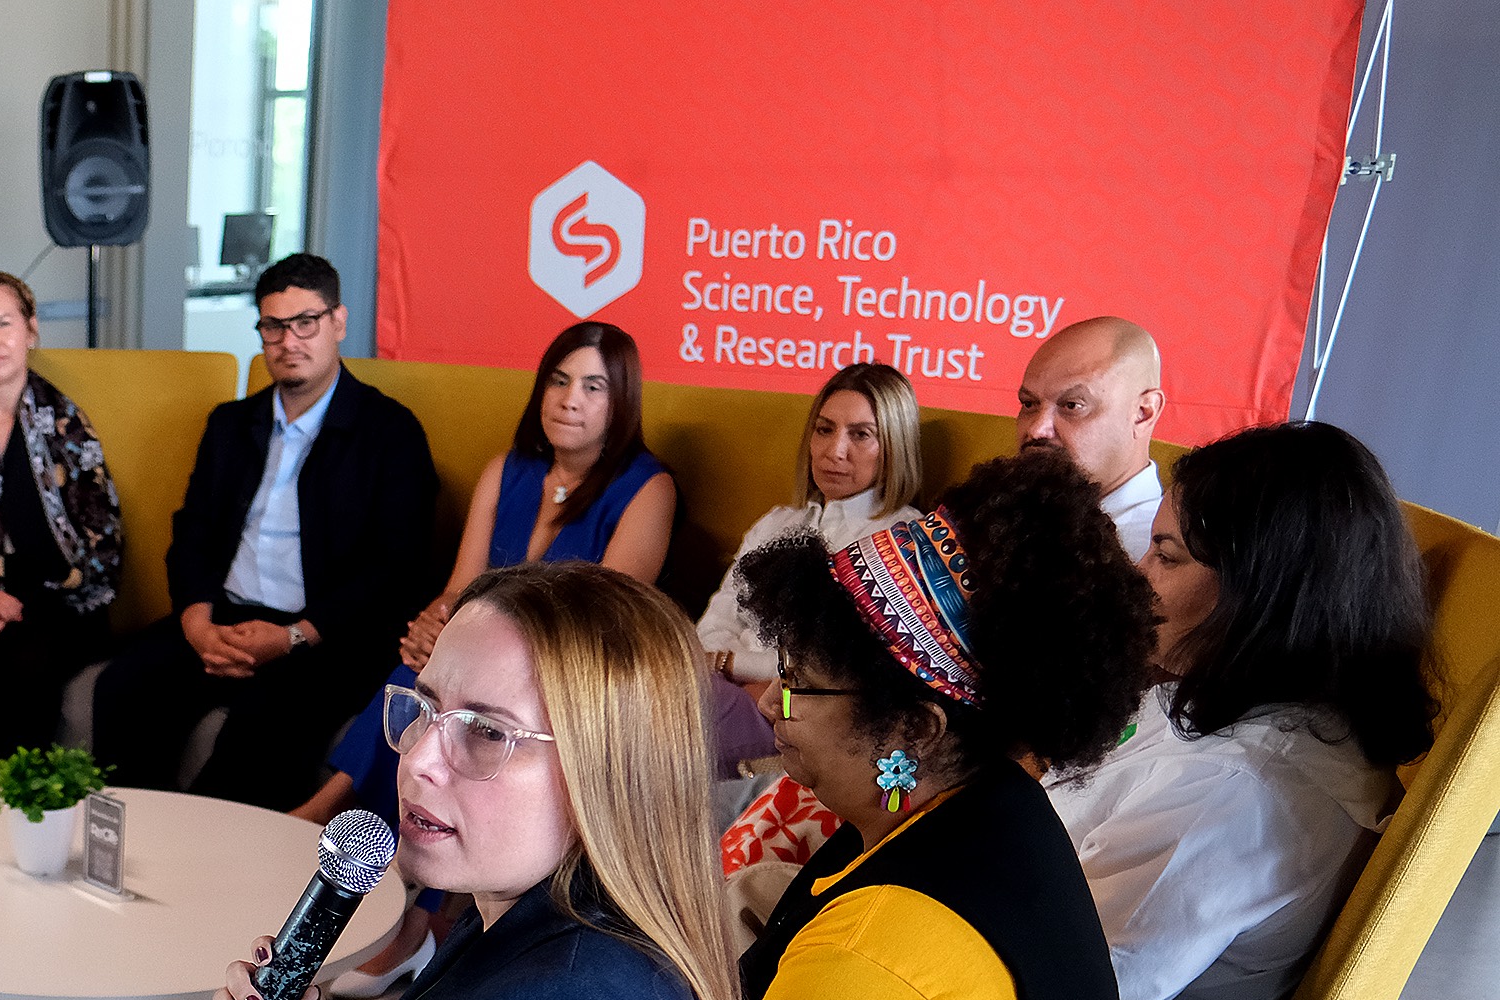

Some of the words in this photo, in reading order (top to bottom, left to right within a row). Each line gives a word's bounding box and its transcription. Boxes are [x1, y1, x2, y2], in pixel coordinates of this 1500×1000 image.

[686, 218, 806, 260] Puerto
[816, 219, 897, 261] Rico
[682, 271, 823, 322] Science,
[837, 276, 1065, 338] Technology
[680, 323, 705, 363] &
[714, 325, 874, 370] Research
[886, 334, 984, 381] Trust
